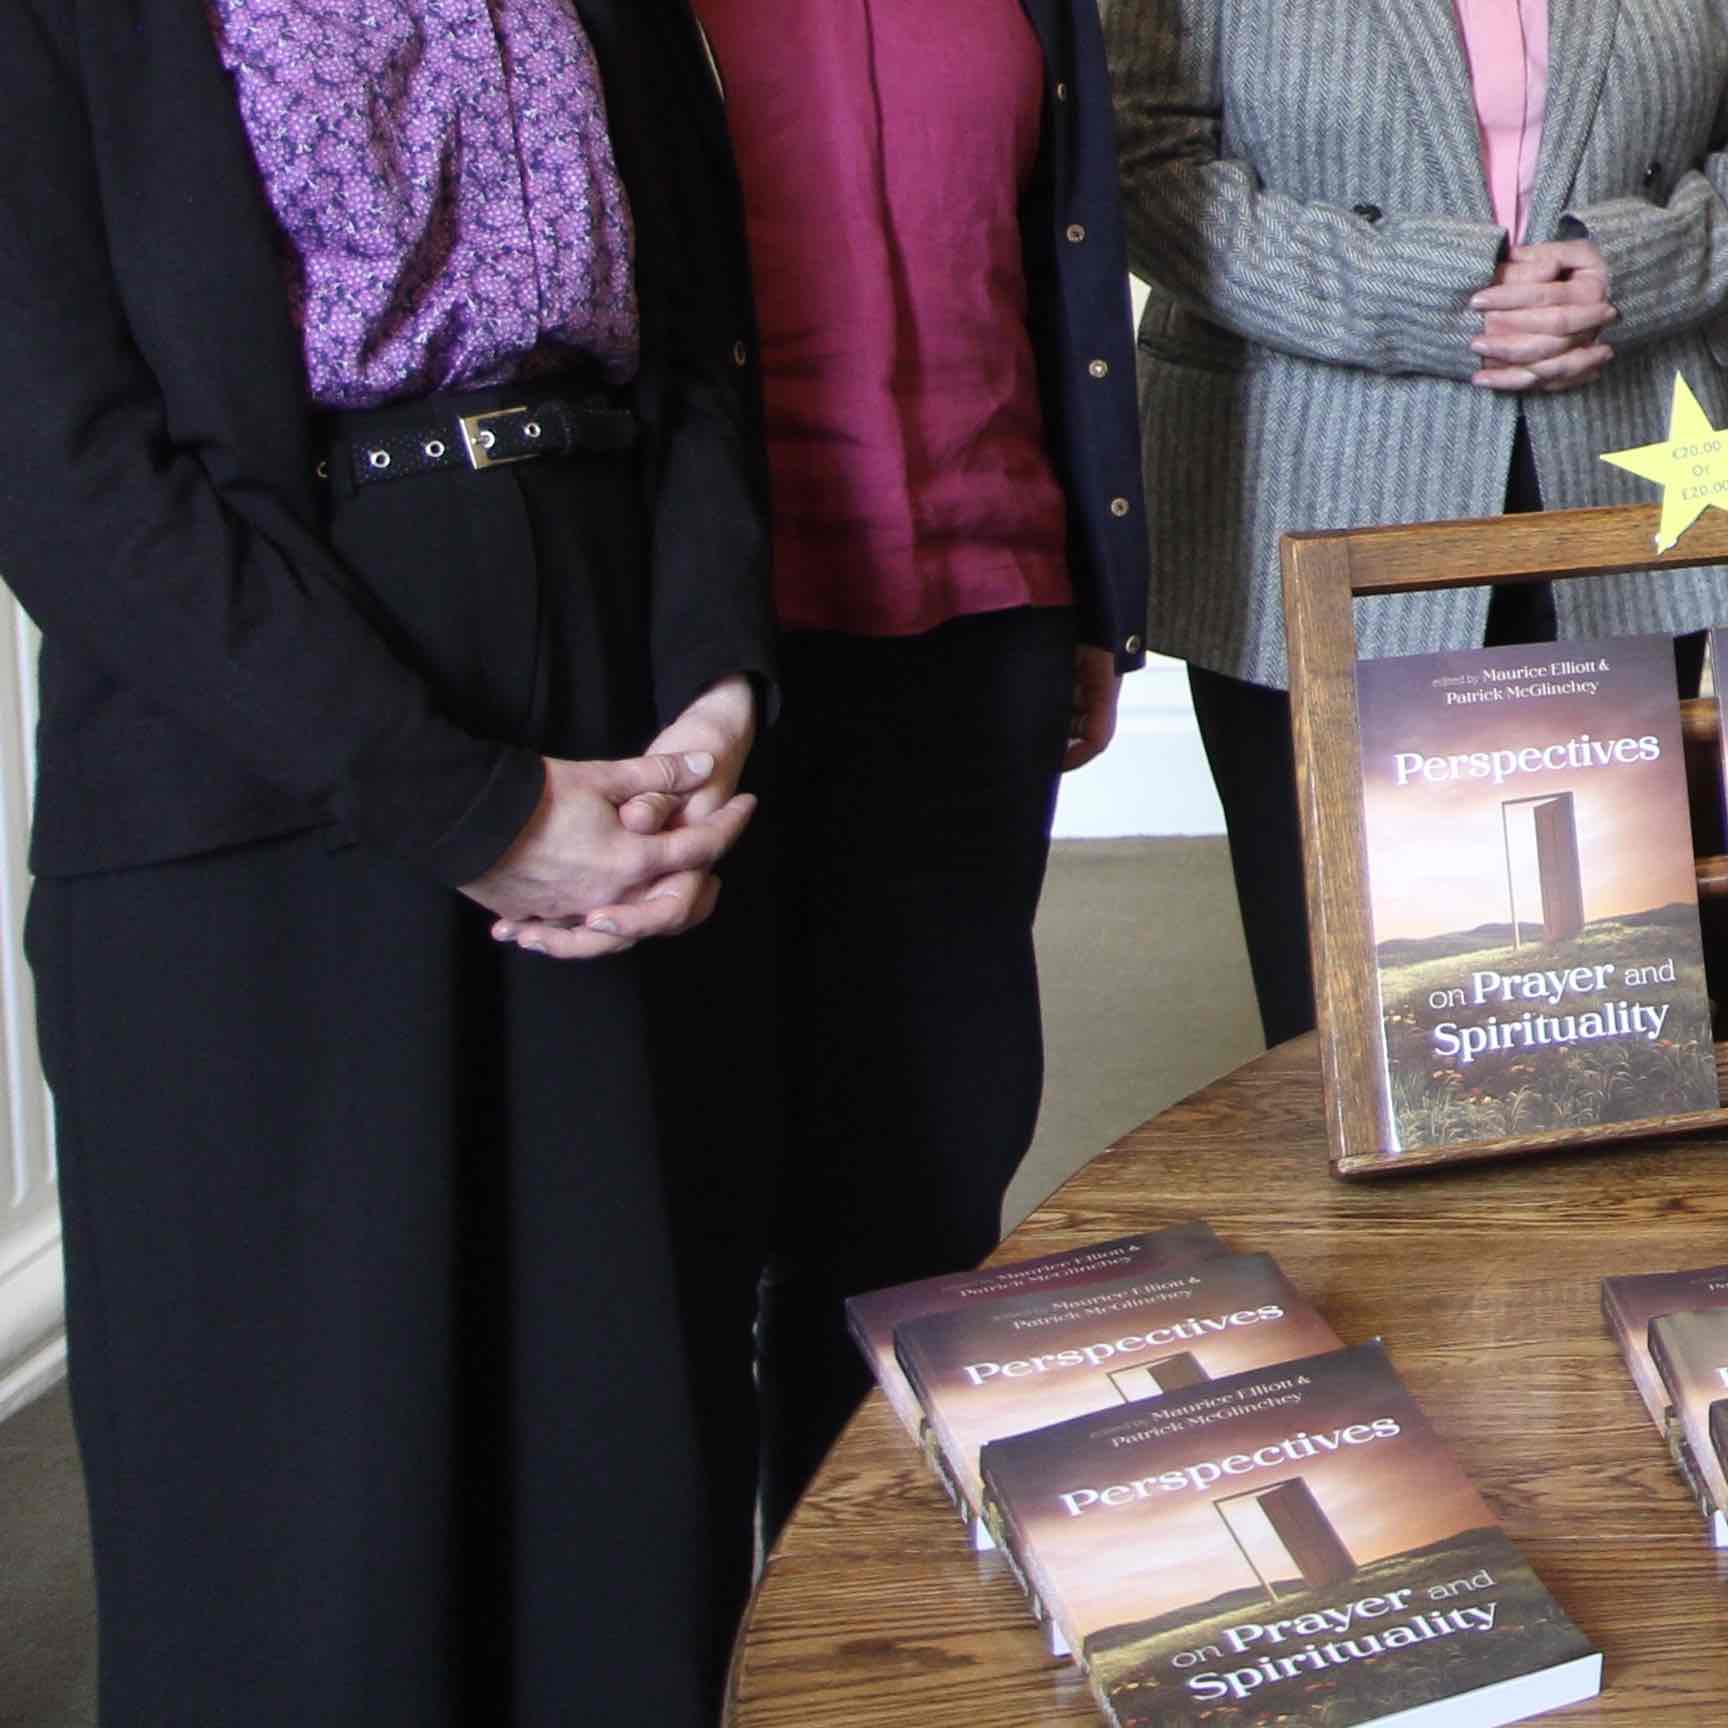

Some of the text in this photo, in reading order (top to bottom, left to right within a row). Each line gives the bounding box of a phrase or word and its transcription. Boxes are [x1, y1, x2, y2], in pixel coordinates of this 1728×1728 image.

[1672, 440, 1721, 459] €20.00
[1692, 464, 1711, 476] Or
[1447, 679, 1599, 704] Patrick McGlinchey
[1483, 664, 1547, 682] Maurice
[1551, 660, 1596, 677] Elliott
[1598, 658, 1610, 671] &
[1394, 734, 1660, 785] Perspectives
[1428, 958, 1676, 1009] on Prayer and
[1434, 1000, 1669, 1062] Spirituality
[1013, 1309, 1080, 1330] Patrick
[1085, 1287, 1193, 1316] McGlinchey
[1051, 1276, 1201, 1311] Maurice Elliott &
[962, 1304, 1285, 1386] Perspectives
[1111, 1422, 1185, 1448] Patrick
[1188, 1392, 1302, 1426] McGlinchey
[1151, 1375, 1312, 1421] Maurice Elliott &
[1058, 1417, 1400, 1518] Perspectives
[1170, 1569, 1497, 1668] on Prayer and
[1188, 1601, 1497, 1701] Spirituality
